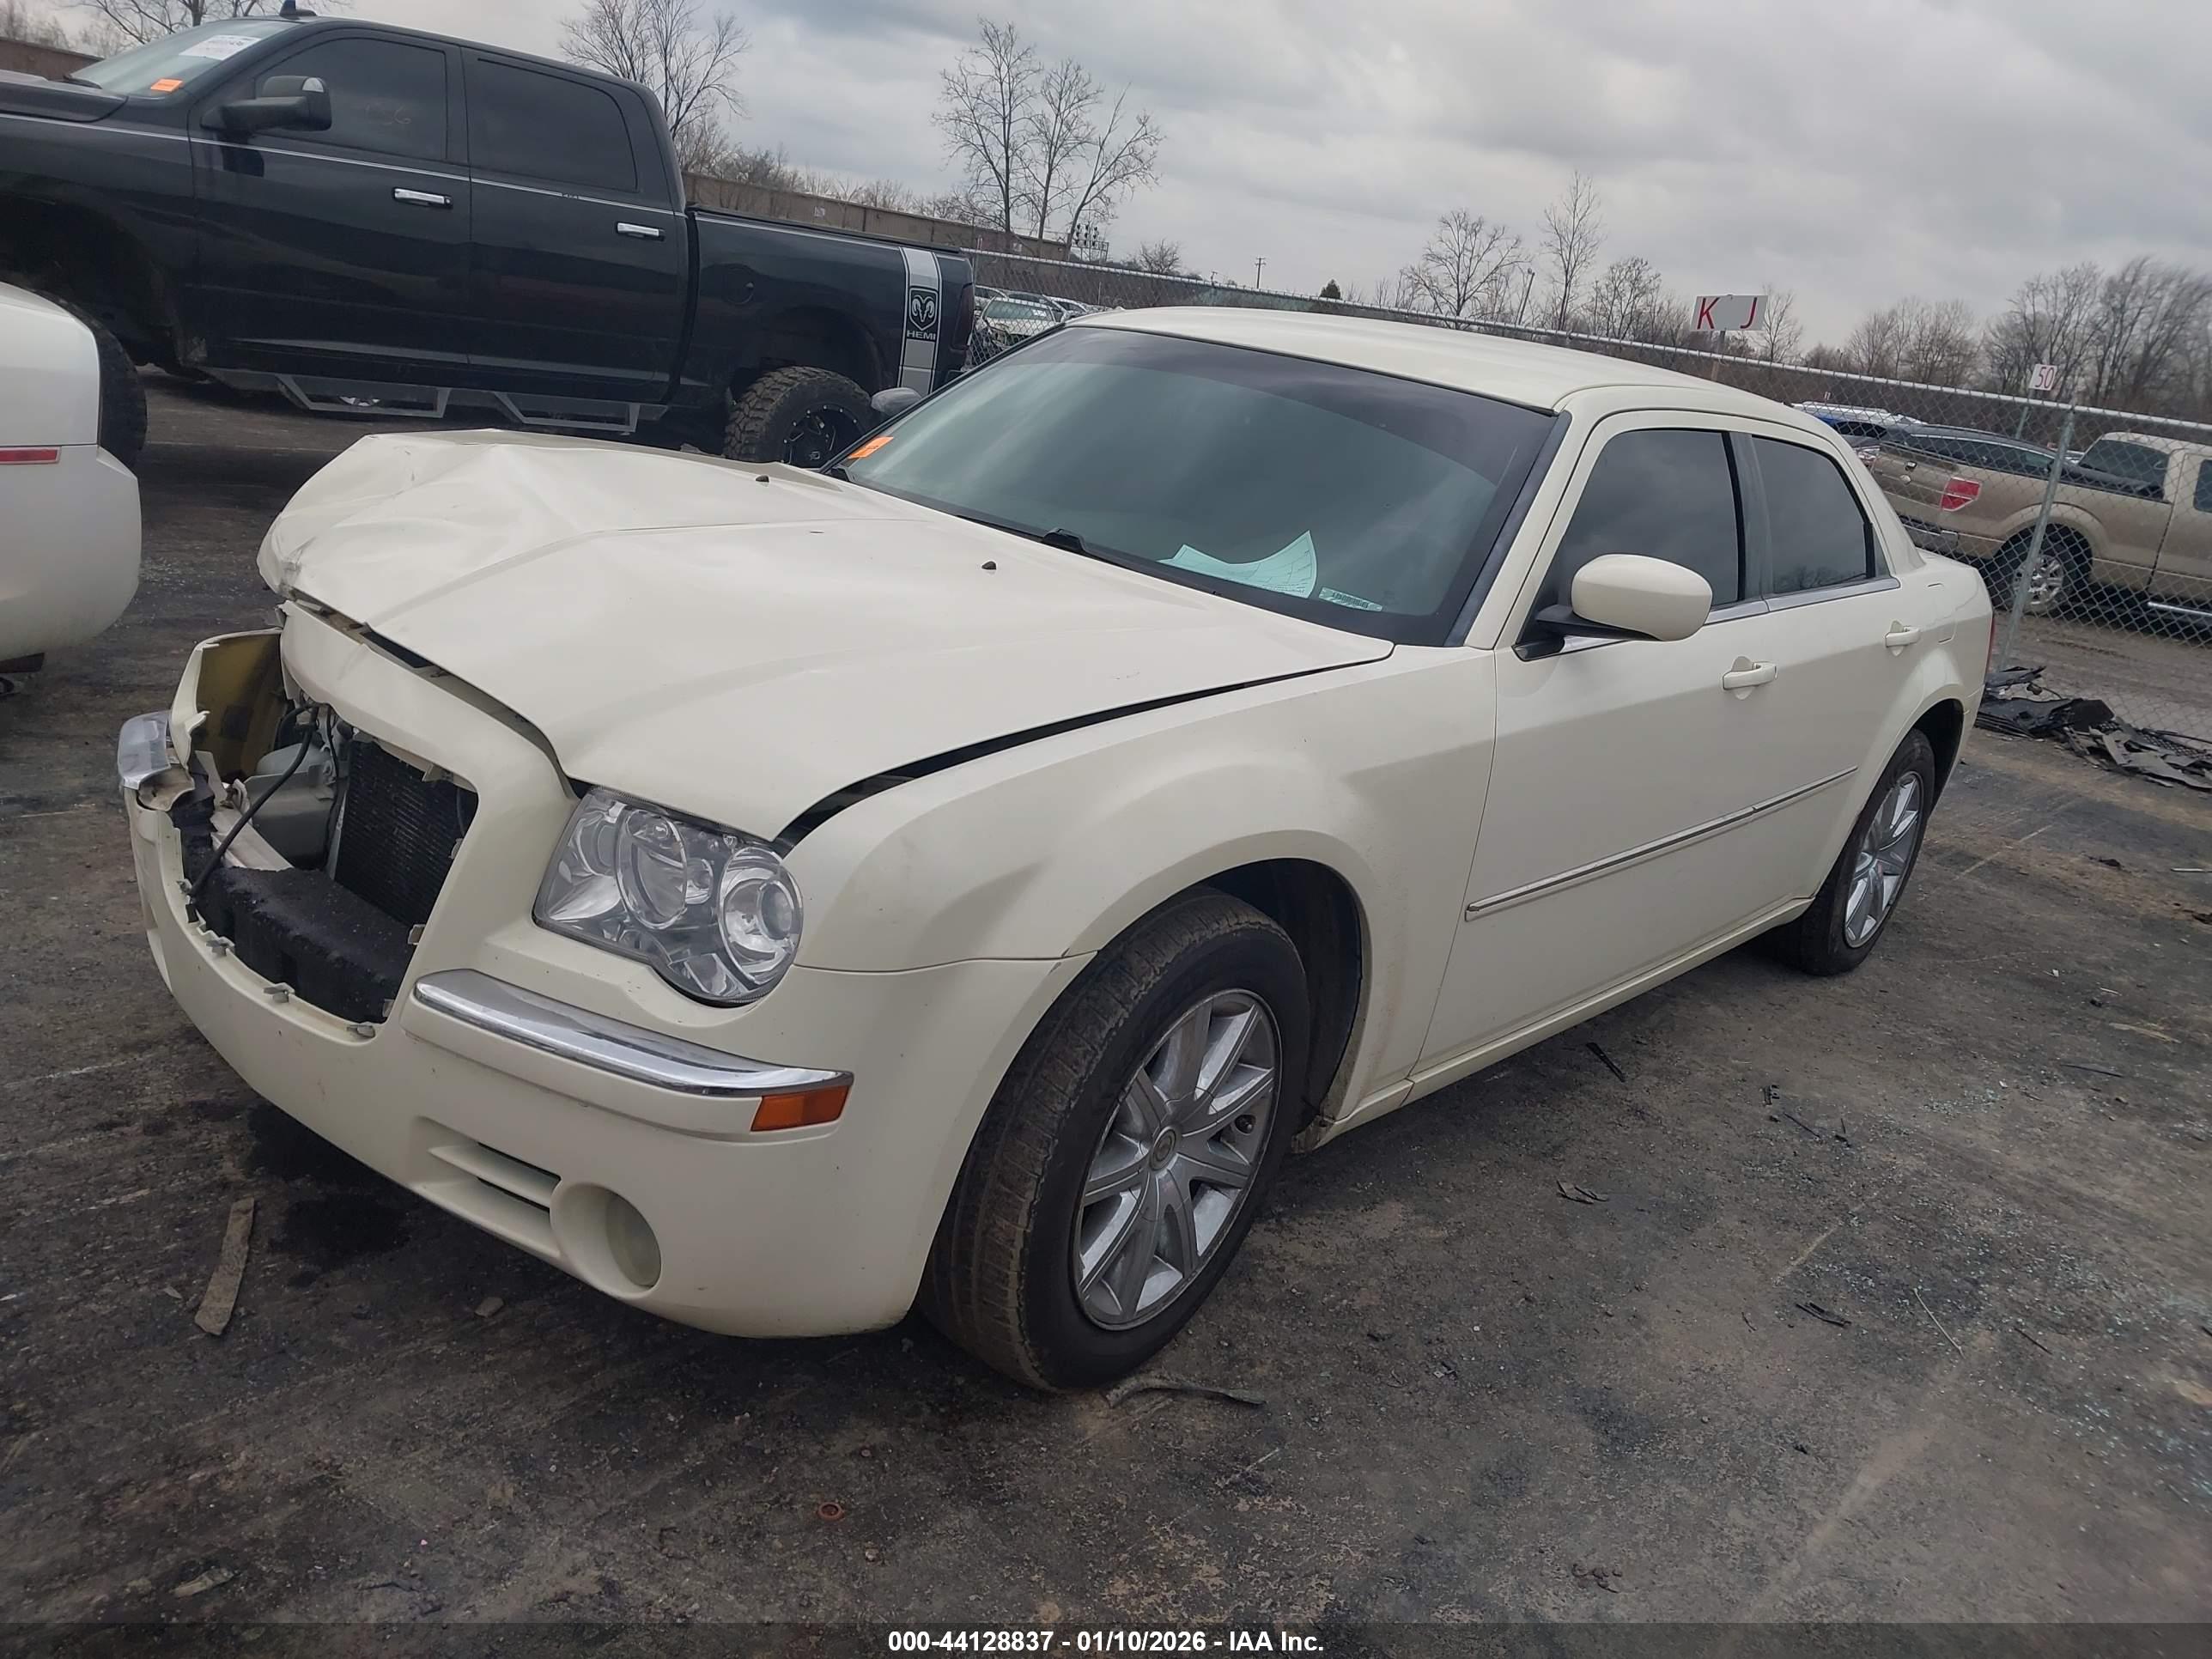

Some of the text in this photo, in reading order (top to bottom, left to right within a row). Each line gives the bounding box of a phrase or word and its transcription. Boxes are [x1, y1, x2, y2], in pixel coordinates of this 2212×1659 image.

[1697, 297, 1758, 330] K J
[907, 330, 936, 340] HEMI
[2035, 367, 2054, 388] 50
